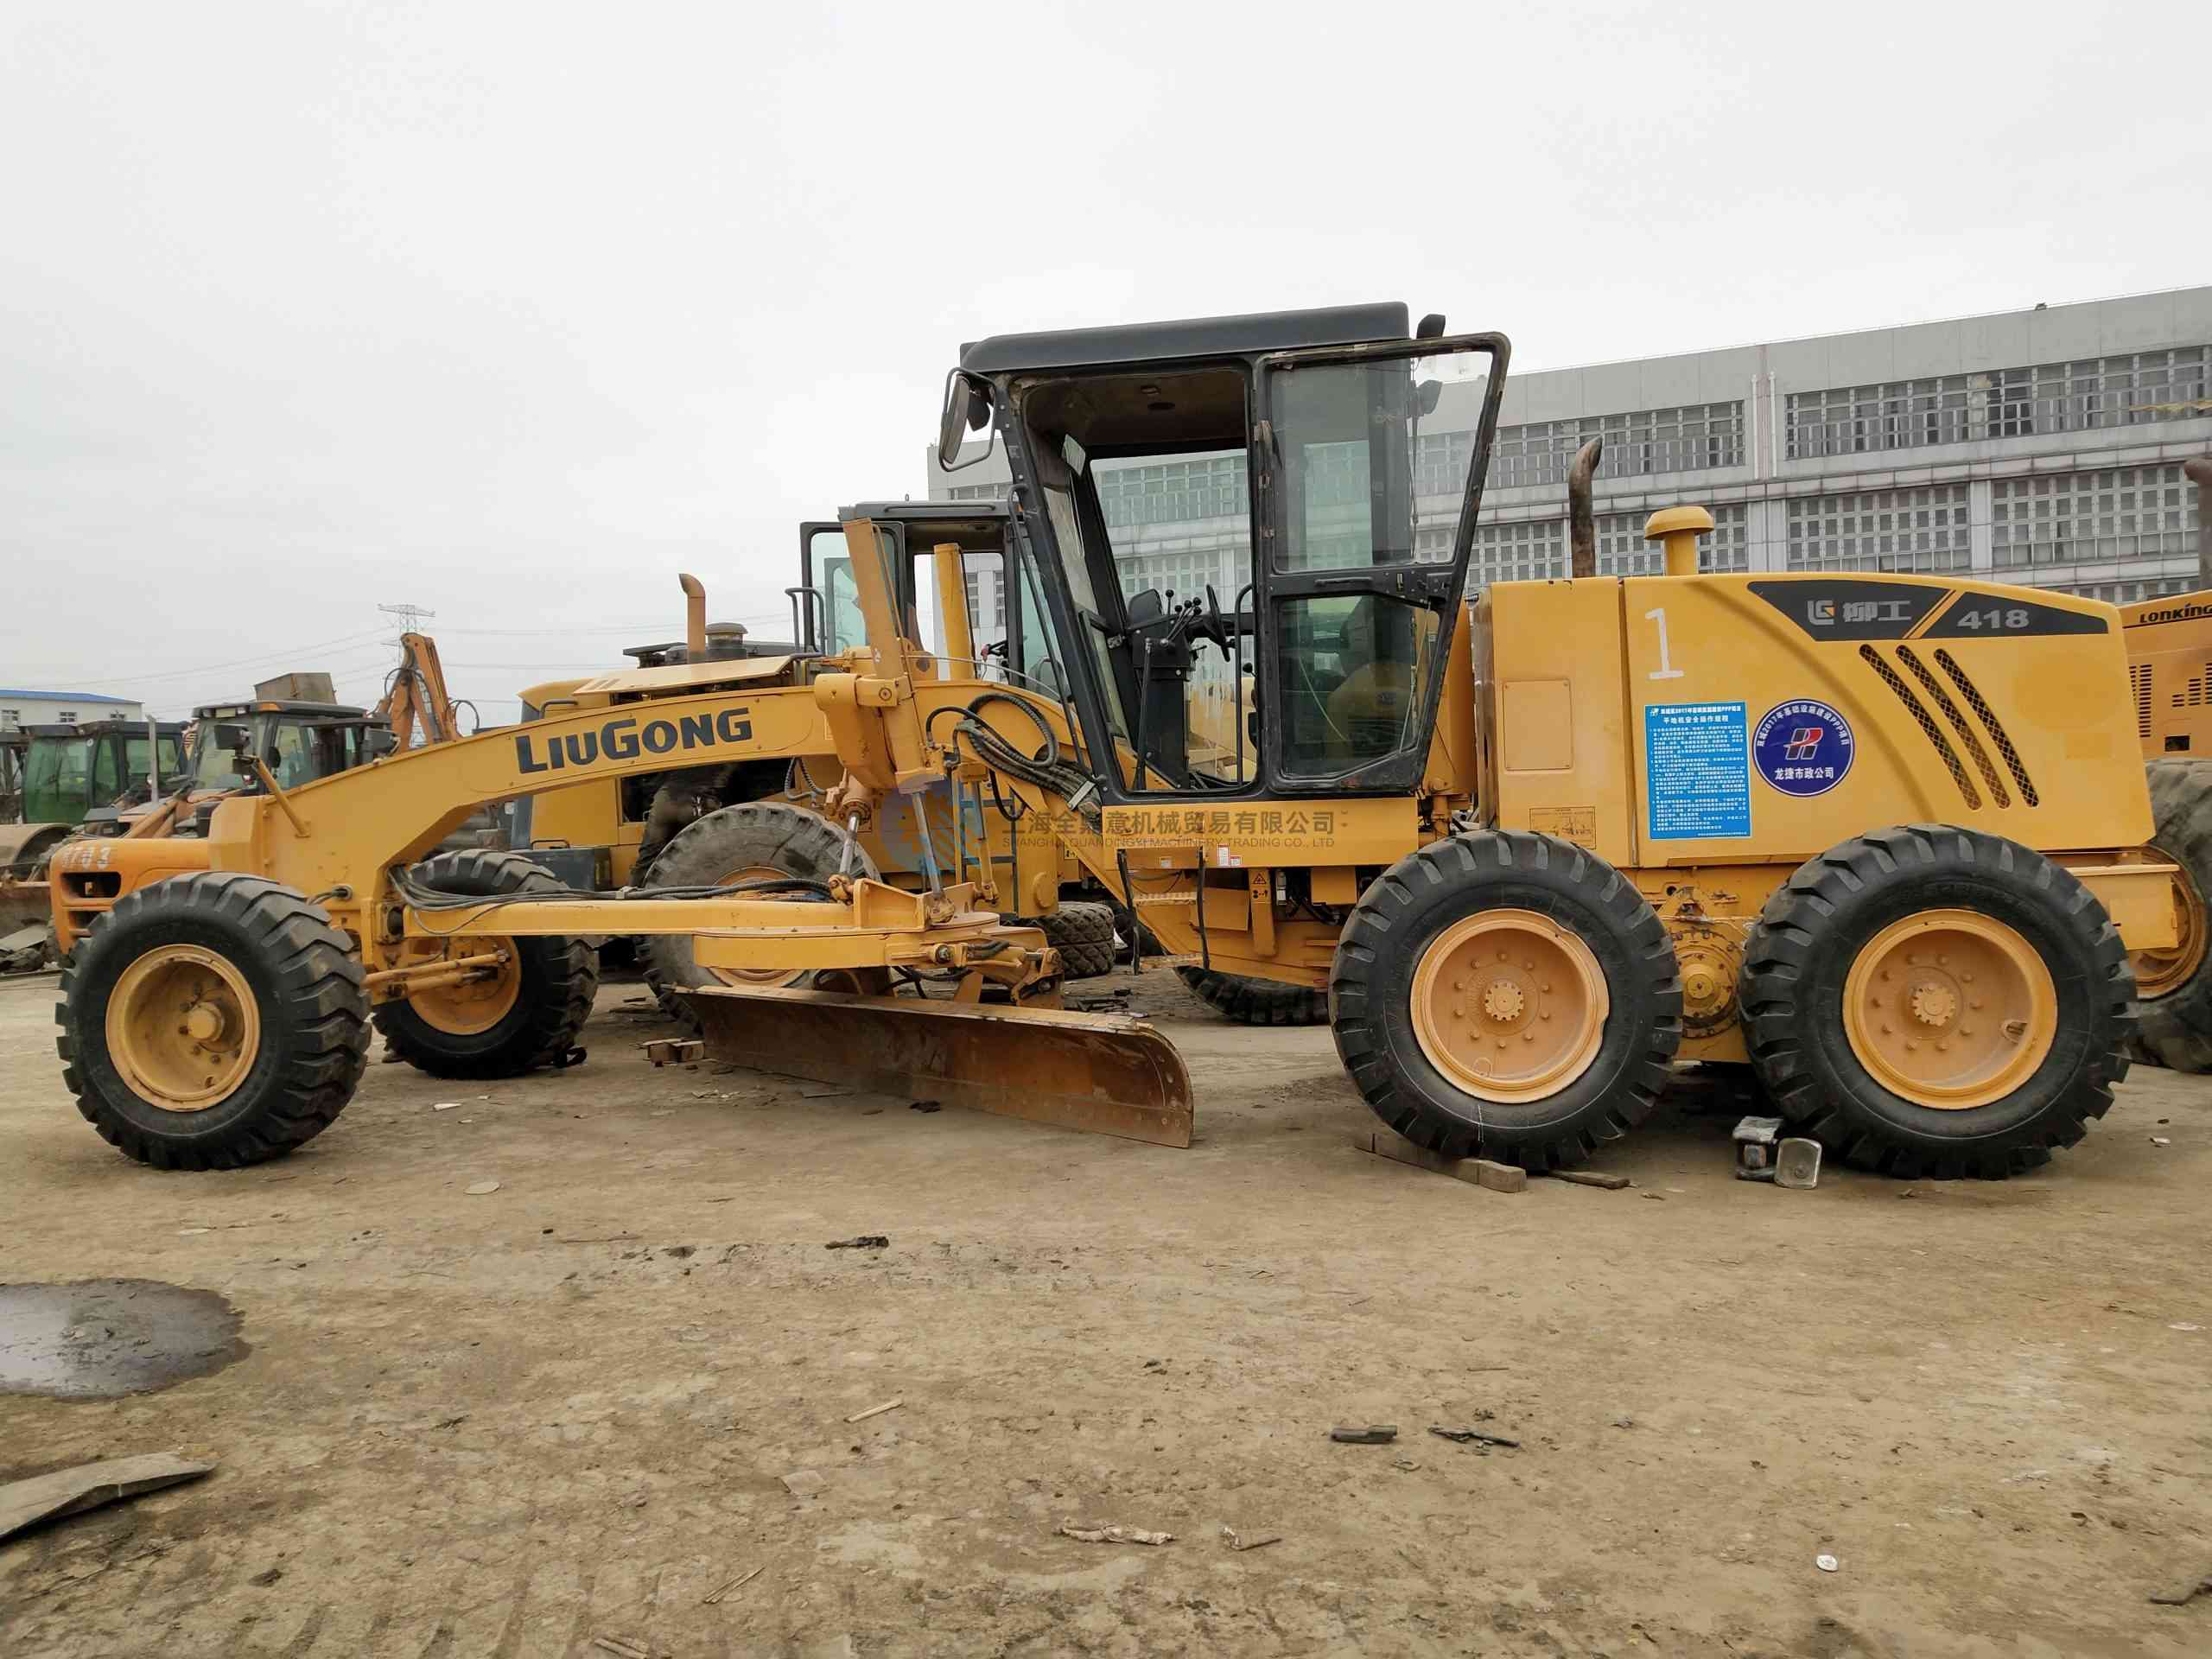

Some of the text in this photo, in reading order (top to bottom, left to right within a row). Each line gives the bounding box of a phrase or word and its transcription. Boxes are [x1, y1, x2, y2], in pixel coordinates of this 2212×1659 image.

[1842, 600, 1912, 622] 柳工
[1957, 608, 2030, 630] 418
[1644, 607, 1685, 680] 1
[515, 707, 753, 775] LIUGONG
[1774, 766, 1834, 780] 龙捷市政公司
